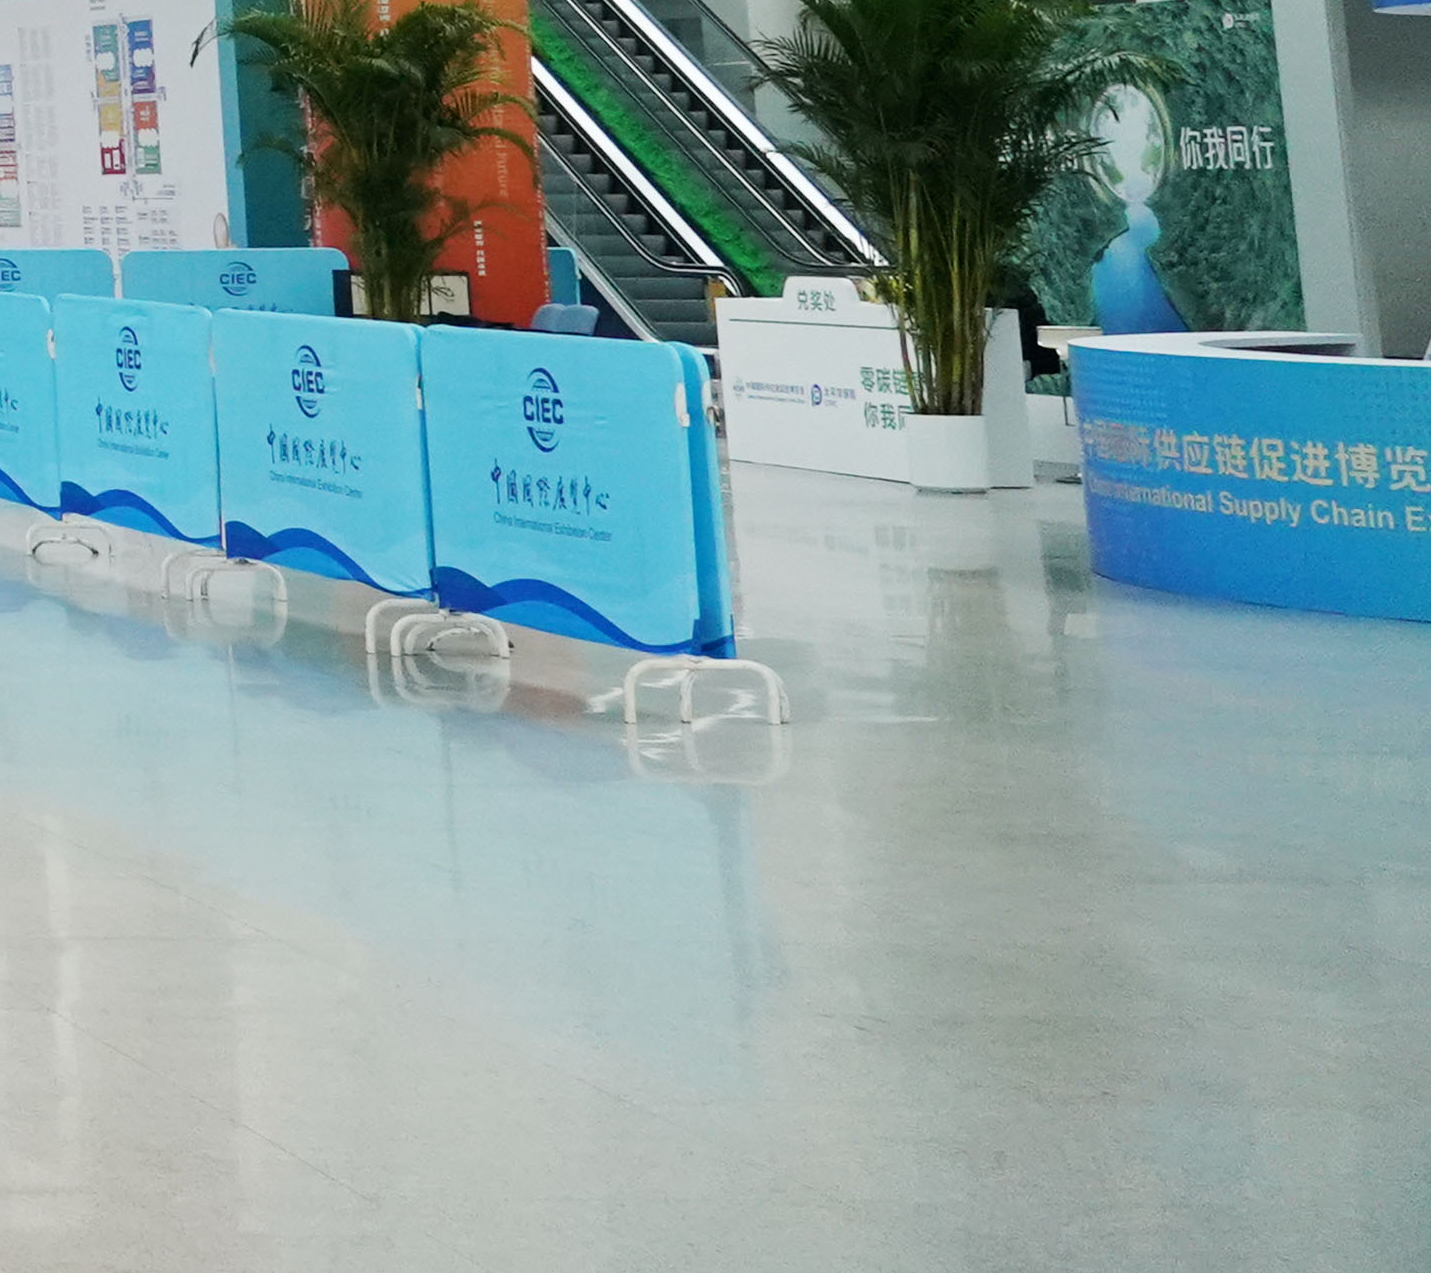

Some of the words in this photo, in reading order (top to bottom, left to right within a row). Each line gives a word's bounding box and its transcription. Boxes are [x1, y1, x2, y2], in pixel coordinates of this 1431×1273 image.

[1179, 125, 1275, 170] 你我同行
[220, 273, 257, 285] CIEC
[116, 348, 141, 370] CIEC
[292, 369, 325, 394] CIEC
[523, 395, 564, 425] CIEC
[1219, 492, 1301, 527] Supply
[1311, 500, 1394, 530] Chain
